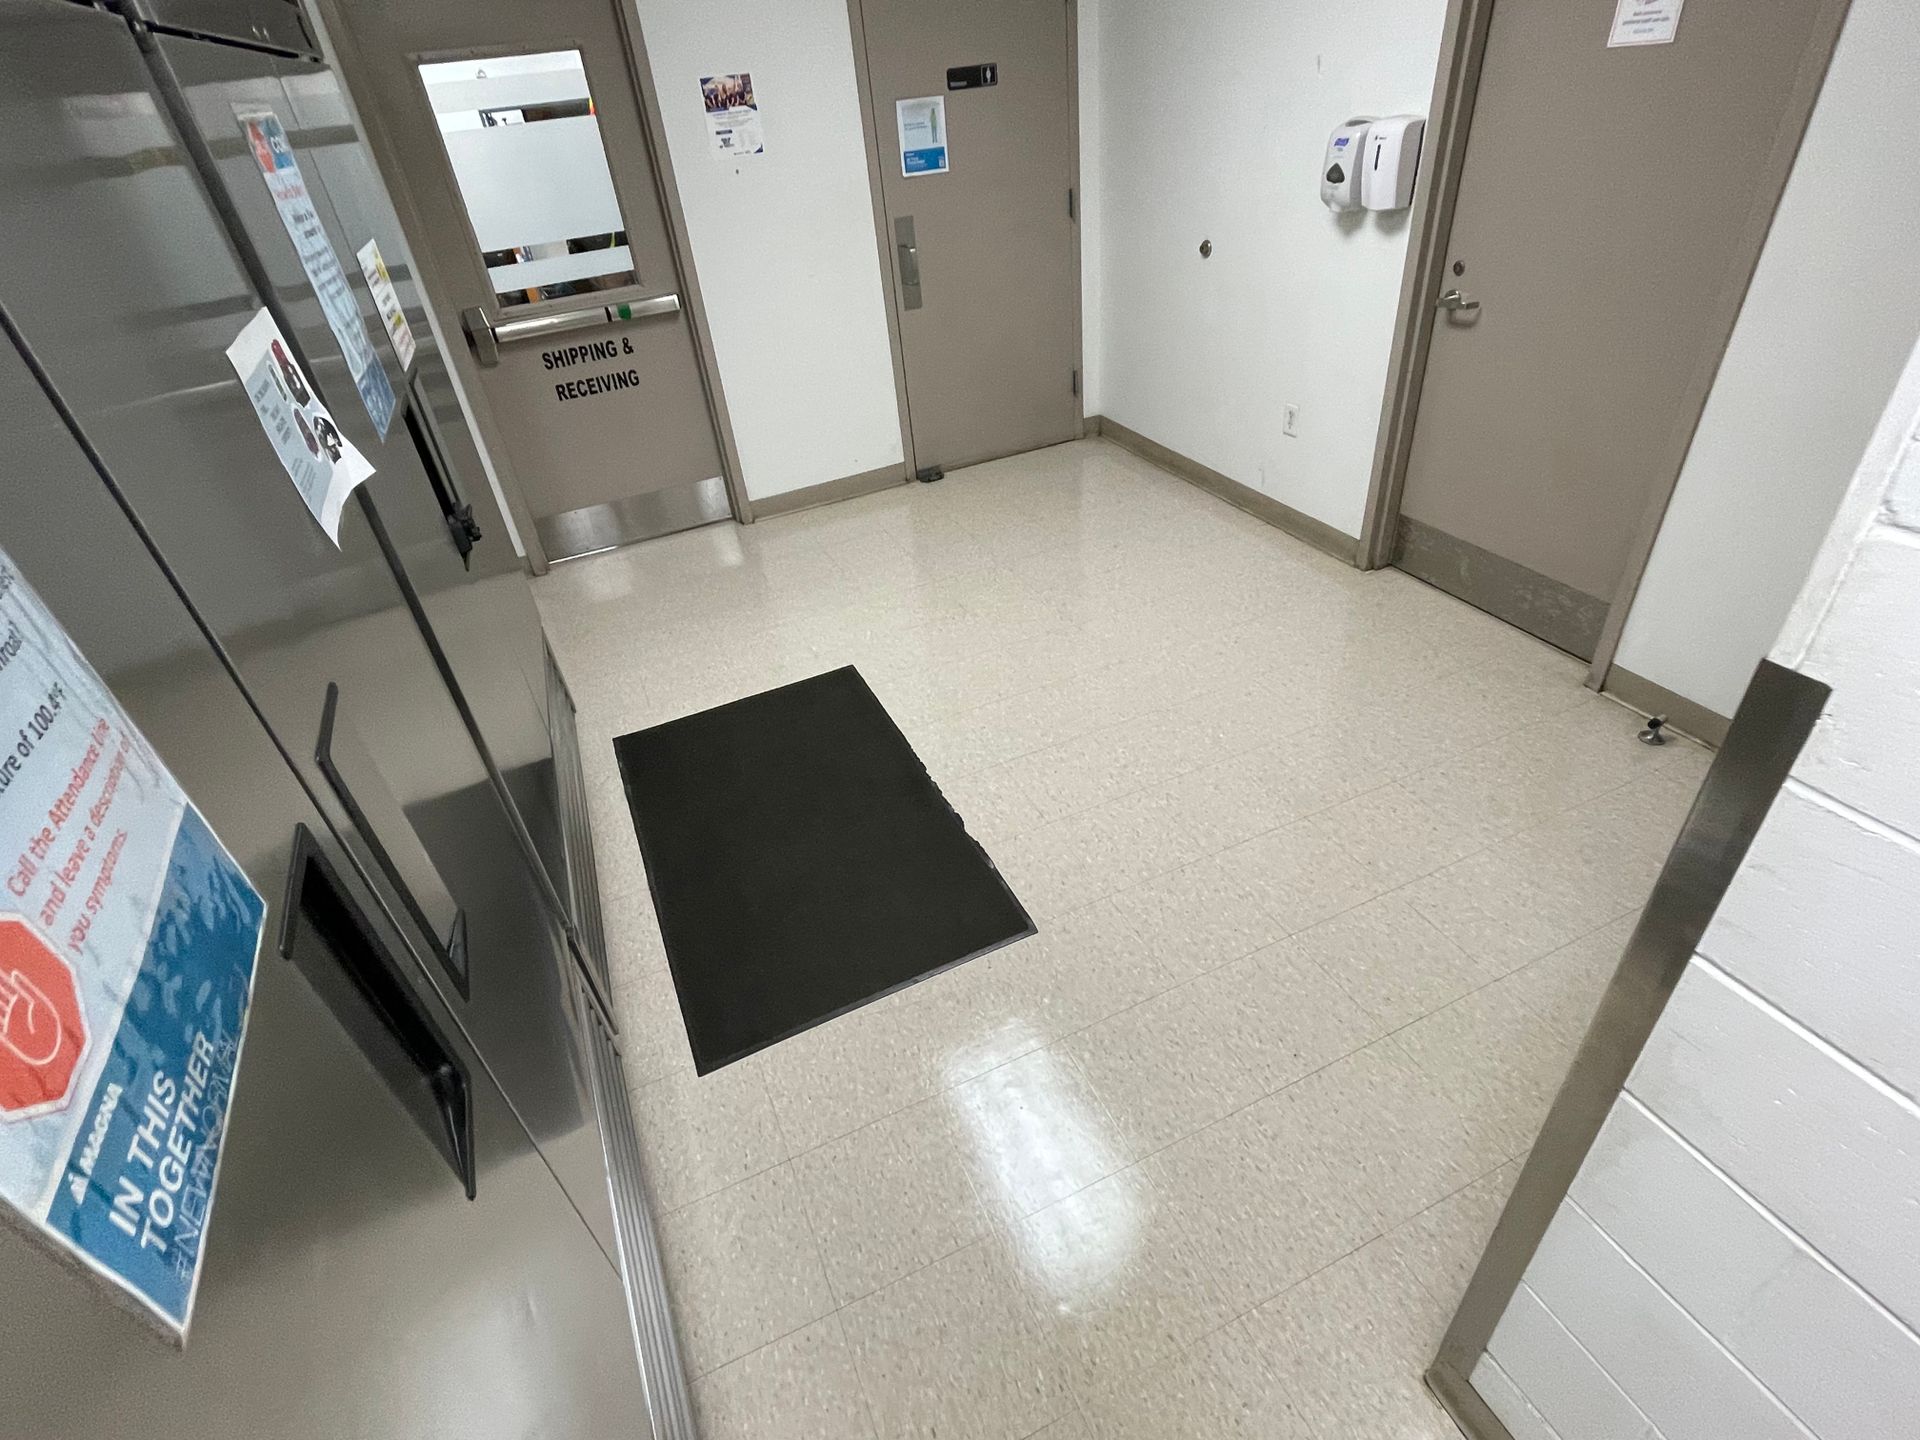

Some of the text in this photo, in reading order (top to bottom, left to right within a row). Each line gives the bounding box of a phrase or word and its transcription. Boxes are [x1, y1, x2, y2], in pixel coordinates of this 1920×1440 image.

[542, 337, 634, 370] SHIPPING &
[555, 369, 640, 401] RECEIVING
[0, 755, 21, 793] ure
[17, 728, 34, 758] of
[7, 853, 38, 896] Call
[29, 827, 56, 860] the
[48, 744, 100, 831] Attendance
[84, 825, 96, 841] a
[52, 839, 90, 888] leave
[41, 880, 66, 926] and
[67, 913, 91, 956] you
[109, 1070, 176, 1236] IN THIS
[141, 1030, 214, 1253] TOGETHER
